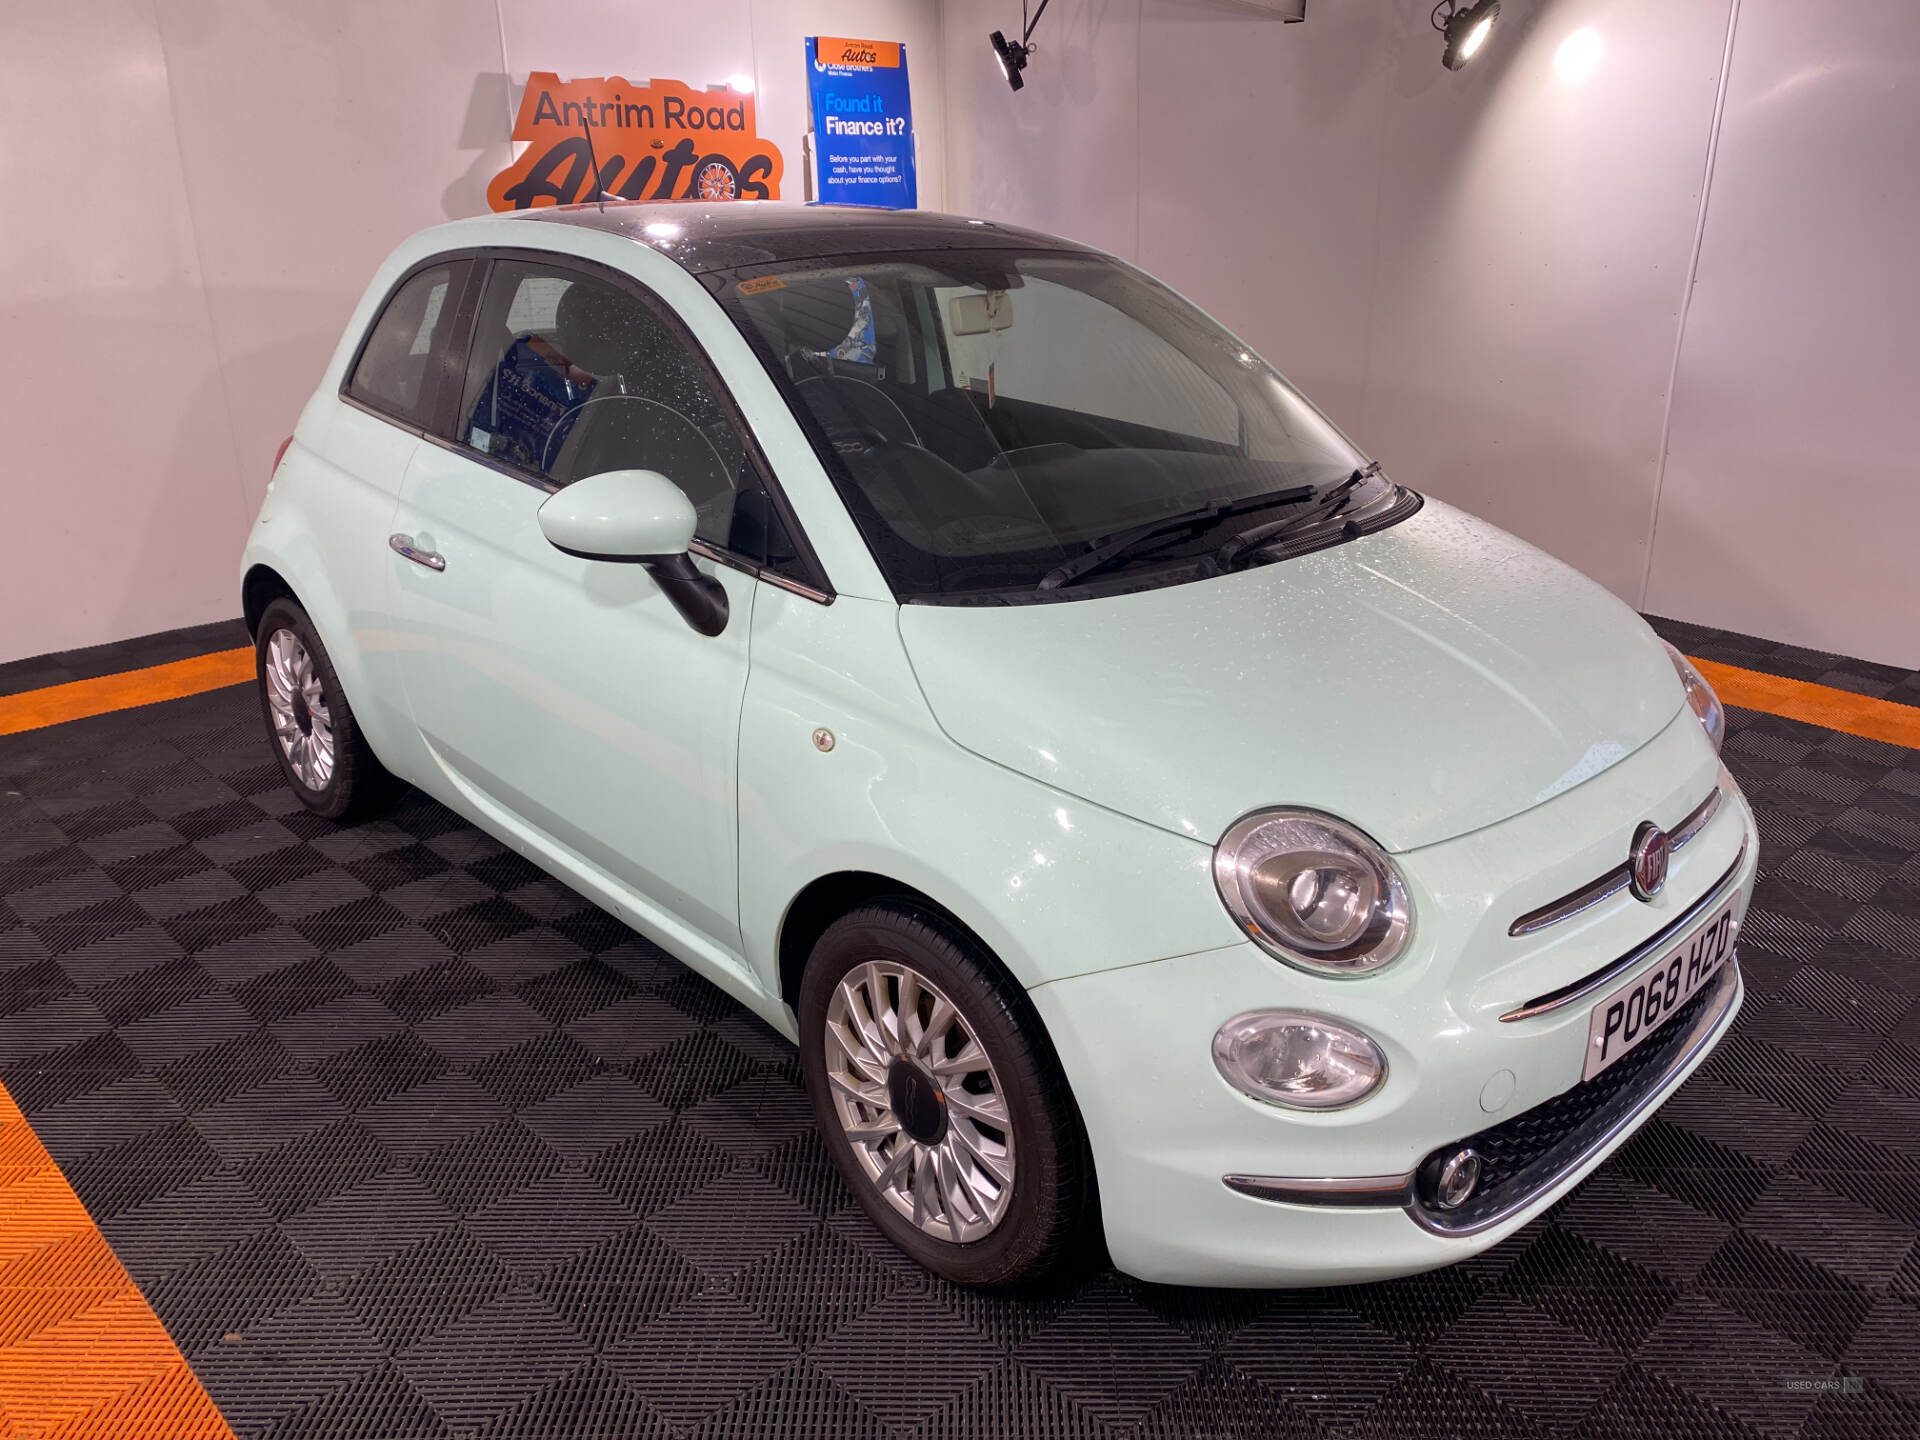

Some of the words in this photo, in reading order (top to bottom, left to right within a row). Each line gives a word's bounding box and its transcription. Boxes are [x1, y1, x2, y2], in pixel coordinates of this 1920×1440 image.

[841, 48, 877, 63] Autos
[532, 90, 654, 128] Antrim
[663, 96, 745, 131] Road
[825, 93, 870, 112] Found
[873, 95, 883, 112] it
[826, 116, 883, 135] Finance
[885, 117, 905, 135] it?
[829, 155, 848, 163] Before
[860, 156, 872, 164] part
[885, 156, 897, 164] your
[503, 137, 773, 209] Autos
[874, 166, 895, 174] thought
[878, 175, 902, 184] options?
[1600, 955, 1683, 1062] PO68
[1685, 909, 1731, 994] HZD
